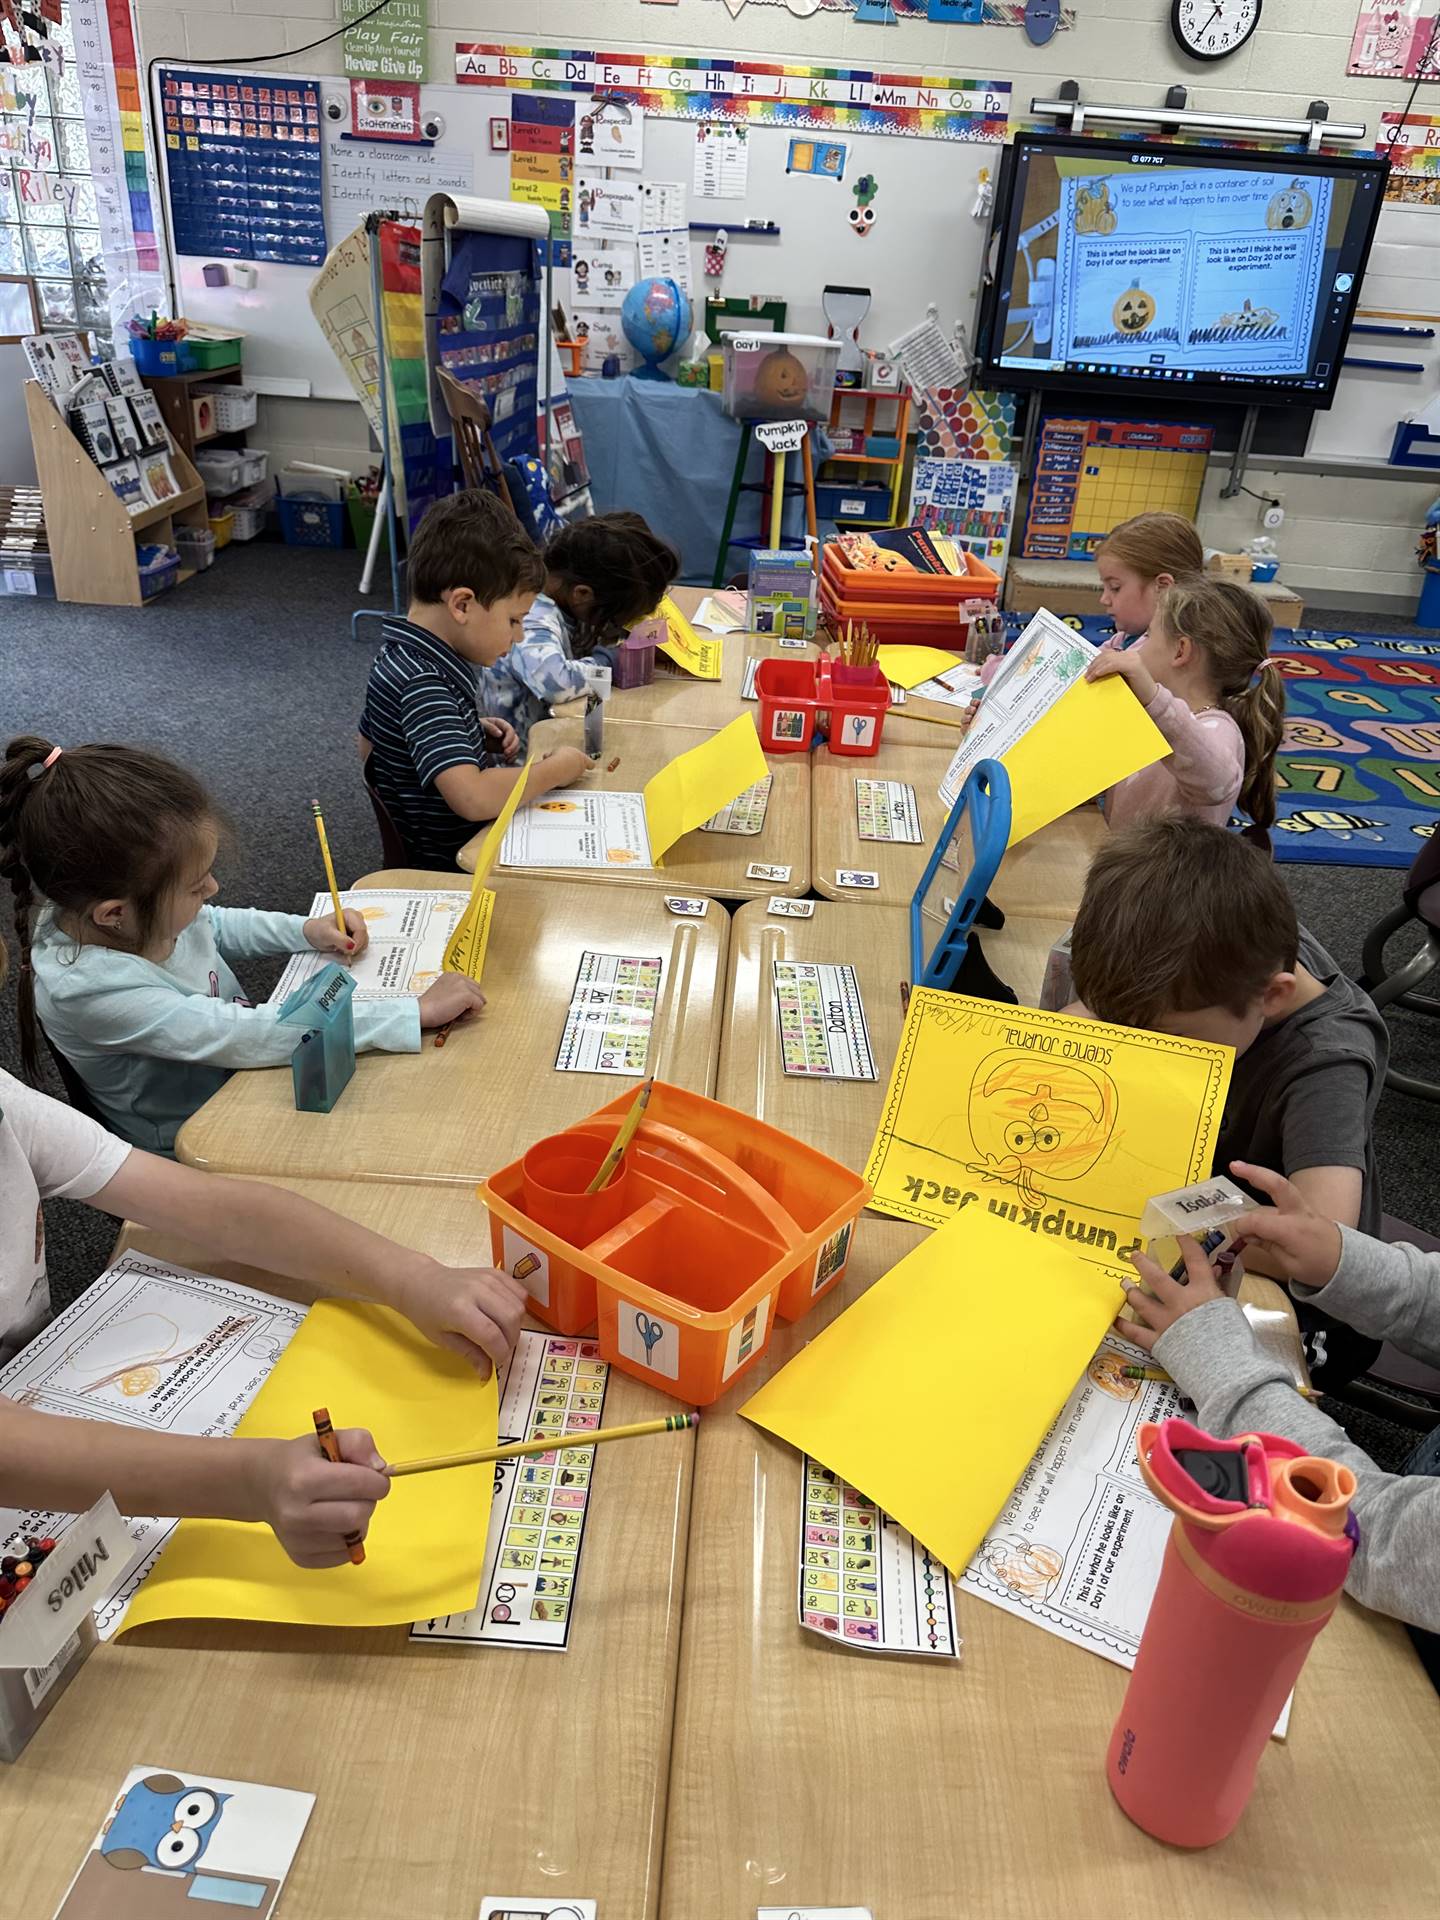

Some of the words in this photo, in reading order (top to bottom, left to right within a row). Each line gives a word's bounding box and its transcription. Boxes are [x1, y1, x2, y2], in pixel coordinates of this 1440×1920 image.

[1186, 2, 1193, 14] 9
[1187, 18, 1195, 30] 8
[1233, 22, 1240, 33] 4
[344, 28, 380, 43] Play
[391, 32, 424, 44] Fair
[1208, 35, 1215, 47] 6
[1221, 33, 1229, 44] 5
[344, 54, 378, 72] Never
[381, 56, 405, 74] Give
[408, 59, 423, 78] Up
[465, 57, 486, 75] Aa
[499, 59, 517, 75] Bb
[532, 61, 550, 78] Cc
[565, 63, 586, 80] Dd
[603, 67, 620, 84] Ee
[638, 68, 652, 86] Ff
[668, 71, 691, 90] Gg
[705, 72, 725, 90] Hh
[742, 76, 754, 92] Ii
[774, 78, 788, 97] Jj
[810, 80, 828, 98] Kk
[850, 84, 863, 101] Ll
[880, 91, 906, 106] Mm
[917, 91, 938, 108] Nn
[950, 92, 972, 110] Oo
[984, 94, 1000, 112] Pp
[330, 144, 352, 157] Name
[369, 148, 409, 161] classroom
[331, 164, 375, 184] Identify
[382, 170, 410, 183] letters
[416, 176, 430, 184] and
[1121, 183, 1133, 193] We
[1135, 183, 1148, 193] put
[1151, 182, 1179, 192] Pumpkin
[1180, 180, 1197, 192] Jack
[1215, 178, 1249, 189] container
[1251, 177, 1260, 186] of
[1262, 176, 1274, 185] soil
[19, 170, 76, 215] Riley
[1122, 199, 1131, 207] to
[1148, 197, 1165, 206] what
[1167, 196, 1177, 205] will
[1179, 196, 1205, 207] happen
[1207, 195, 1214, 204] to
[1217, 195, 1230, 203] him
[1232, 194, 1251, 202] over
[1087, 250, 1100, 258] This
[1109, 249, 1127, 257] what
[1209, 247, 1222, 255] This
[1231, 246, 1248, 254] what
[592, 259, 612, 269] Caring
[1085, 259, 1100, 267] Day
[1106, 258, 1114, 266] of
[1207, 256, 1222, 264] look
[1224, 255, 1236, 263] like
[1248, 254, 1261, 263] Day
[1274, 253, 1282, 261] of
[1228, 262, 1272, 272] experiment.
[593, 322, 610, 332] Safe
[736, 341, 755, 350] Day
[758, 423, 805, 436] Pumpkin
[771, 439, 797, 450] Jack
[1327, 690, 1391, 714] 9
[318, 972, 349, 1012] Annabel
[827, 1001, 847, 1033] Dalton
[902, 1174, 980, 1214] Jack
[1176, 1189, 1230, 1214] Isabel
[988, 1198, 1143, 1264] Pumpkin
[217, 1315, 235, 1330] Day
[206, 1333, 216, 1342] of
[194, 1342, 207, 1355] our
[204, 1339, 223, 1357] what
[194, 1357, 207, 1367] he
[148, 1355, 194, 1398] experiment.
[174, 1367, 197, 1387] looks
[160, 1387, 177, 1401] like
[149, 1402, 161, 1412] on
[1072, 1403, 1084, 1421] over
[1064, 1422, 1076, 1434] him
[1060, 1435, 1071, 1443] to
[1049, 1445, 1066, 1472] happen
[1045, 1472, 1054, 1484] will
[1038, 1485, 1049, 1504] what
[1115, 1493, 1125, 1504] on
[999, 1511, 1016, 1525] We
[1010, 1495, 1022, 1511] put
[1028, 1506, 1041, 1521] see
[1108, 1504, 1121, 1519] like
[1022, 1522, 1034, 1532] to
[1099, 1519, 1115, 1541] looks
[1110, 1509, 1134, 1557] experiment.
[1095, 1542, 1107, 1554] he
[1088, 1553, 1102, 1575] what
[1104, 1557, 1115, 1573] our
[47, 1536, 110, 1612] Miles
[1083, 1577, 1094, 1585] is
[1100, 1573, 1109, 1584] of
[1076, 1585, 1090, 1602] This
[1089, 1589, 1105, 1609] Day
